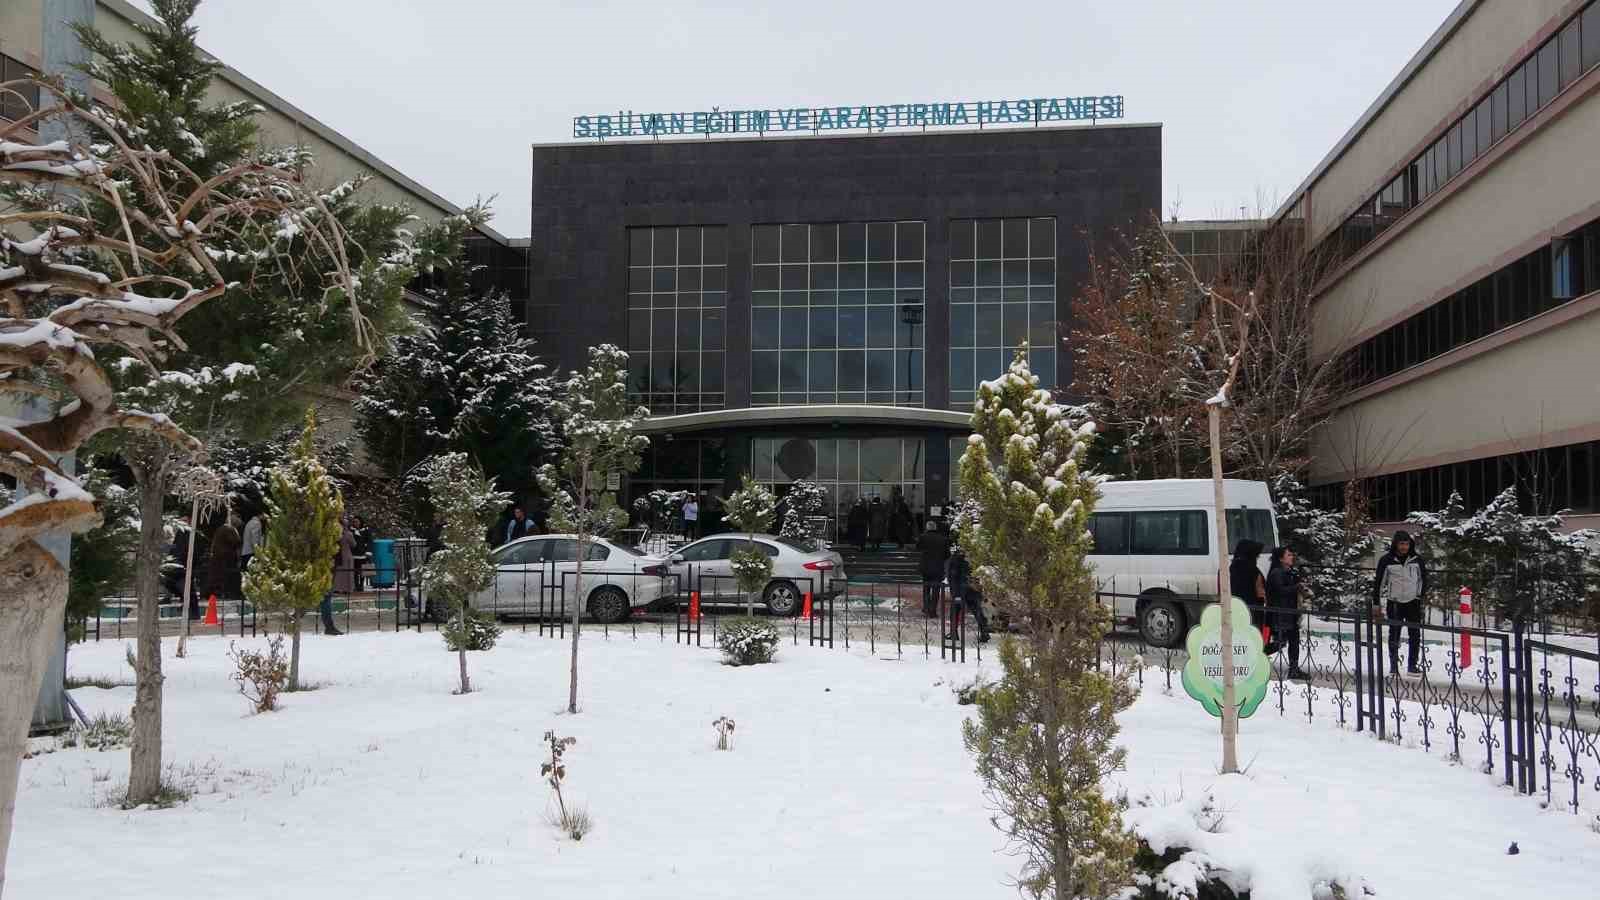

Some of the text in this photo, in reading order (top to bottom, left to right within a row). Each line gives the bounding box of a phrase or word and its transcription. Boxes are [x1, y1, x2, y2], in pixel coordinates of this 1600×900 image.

[777, 108, 810, 131] VE
[818, 102, 969, 132] ARAŞTIRMA
[1233, 645, 1248, 656] SEV
[1203, 663, 1225, 678] YEŞİL
